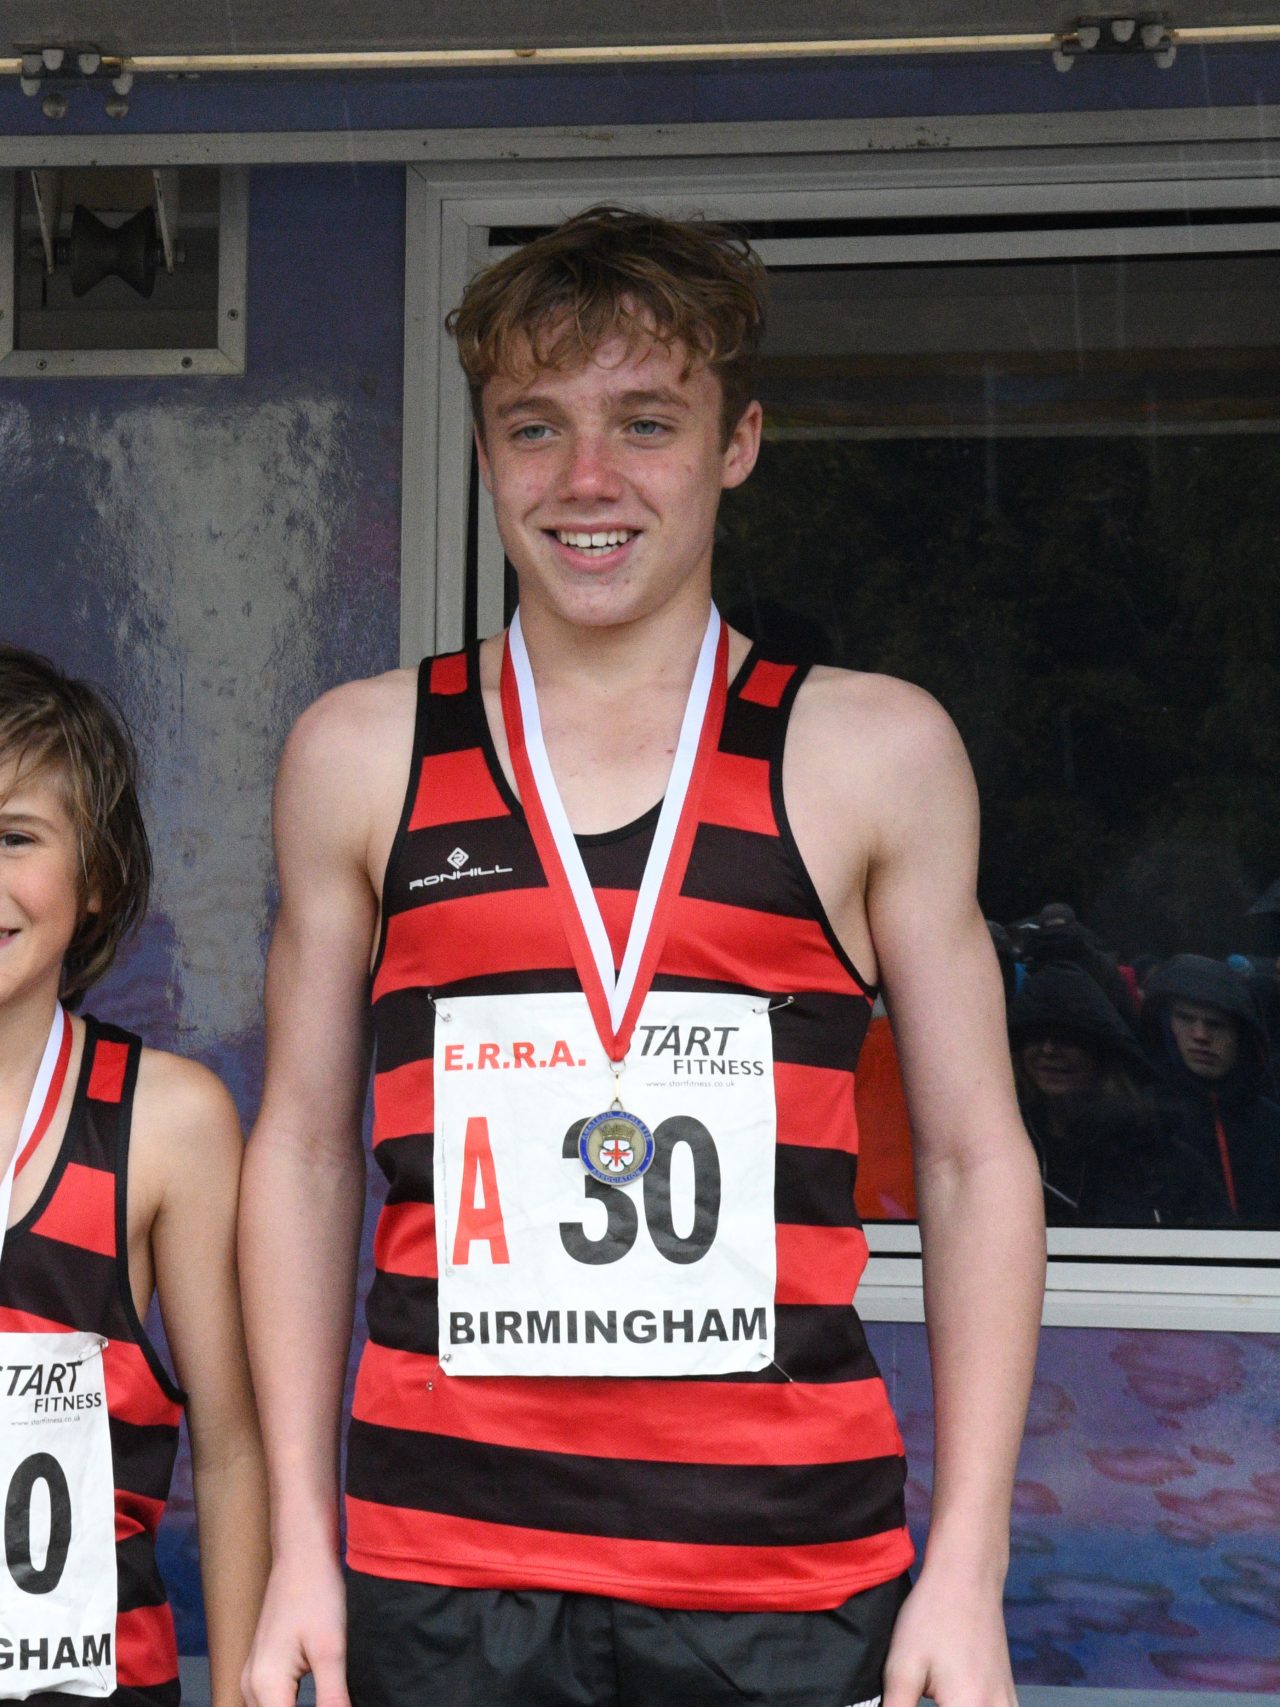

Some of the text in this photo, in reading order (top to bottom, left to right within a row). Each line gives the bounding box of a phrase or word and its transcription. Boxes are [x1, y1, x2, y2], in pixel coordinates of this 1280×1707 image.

[409, 864, 513, 891] RONHILL
[444, 1040, 587, 1071] E.R.R.A.
[626, 1025, 740, 1057] TART
[673, 1059, 765, 1076] FITNESS
[452, 1116, 510, 1265] A
[559, 1115, 721, 1265] 30
[449, 1307, 768, 1345] BIRMINGHAM
[34, 1392, 103, 1414] FITNESS
